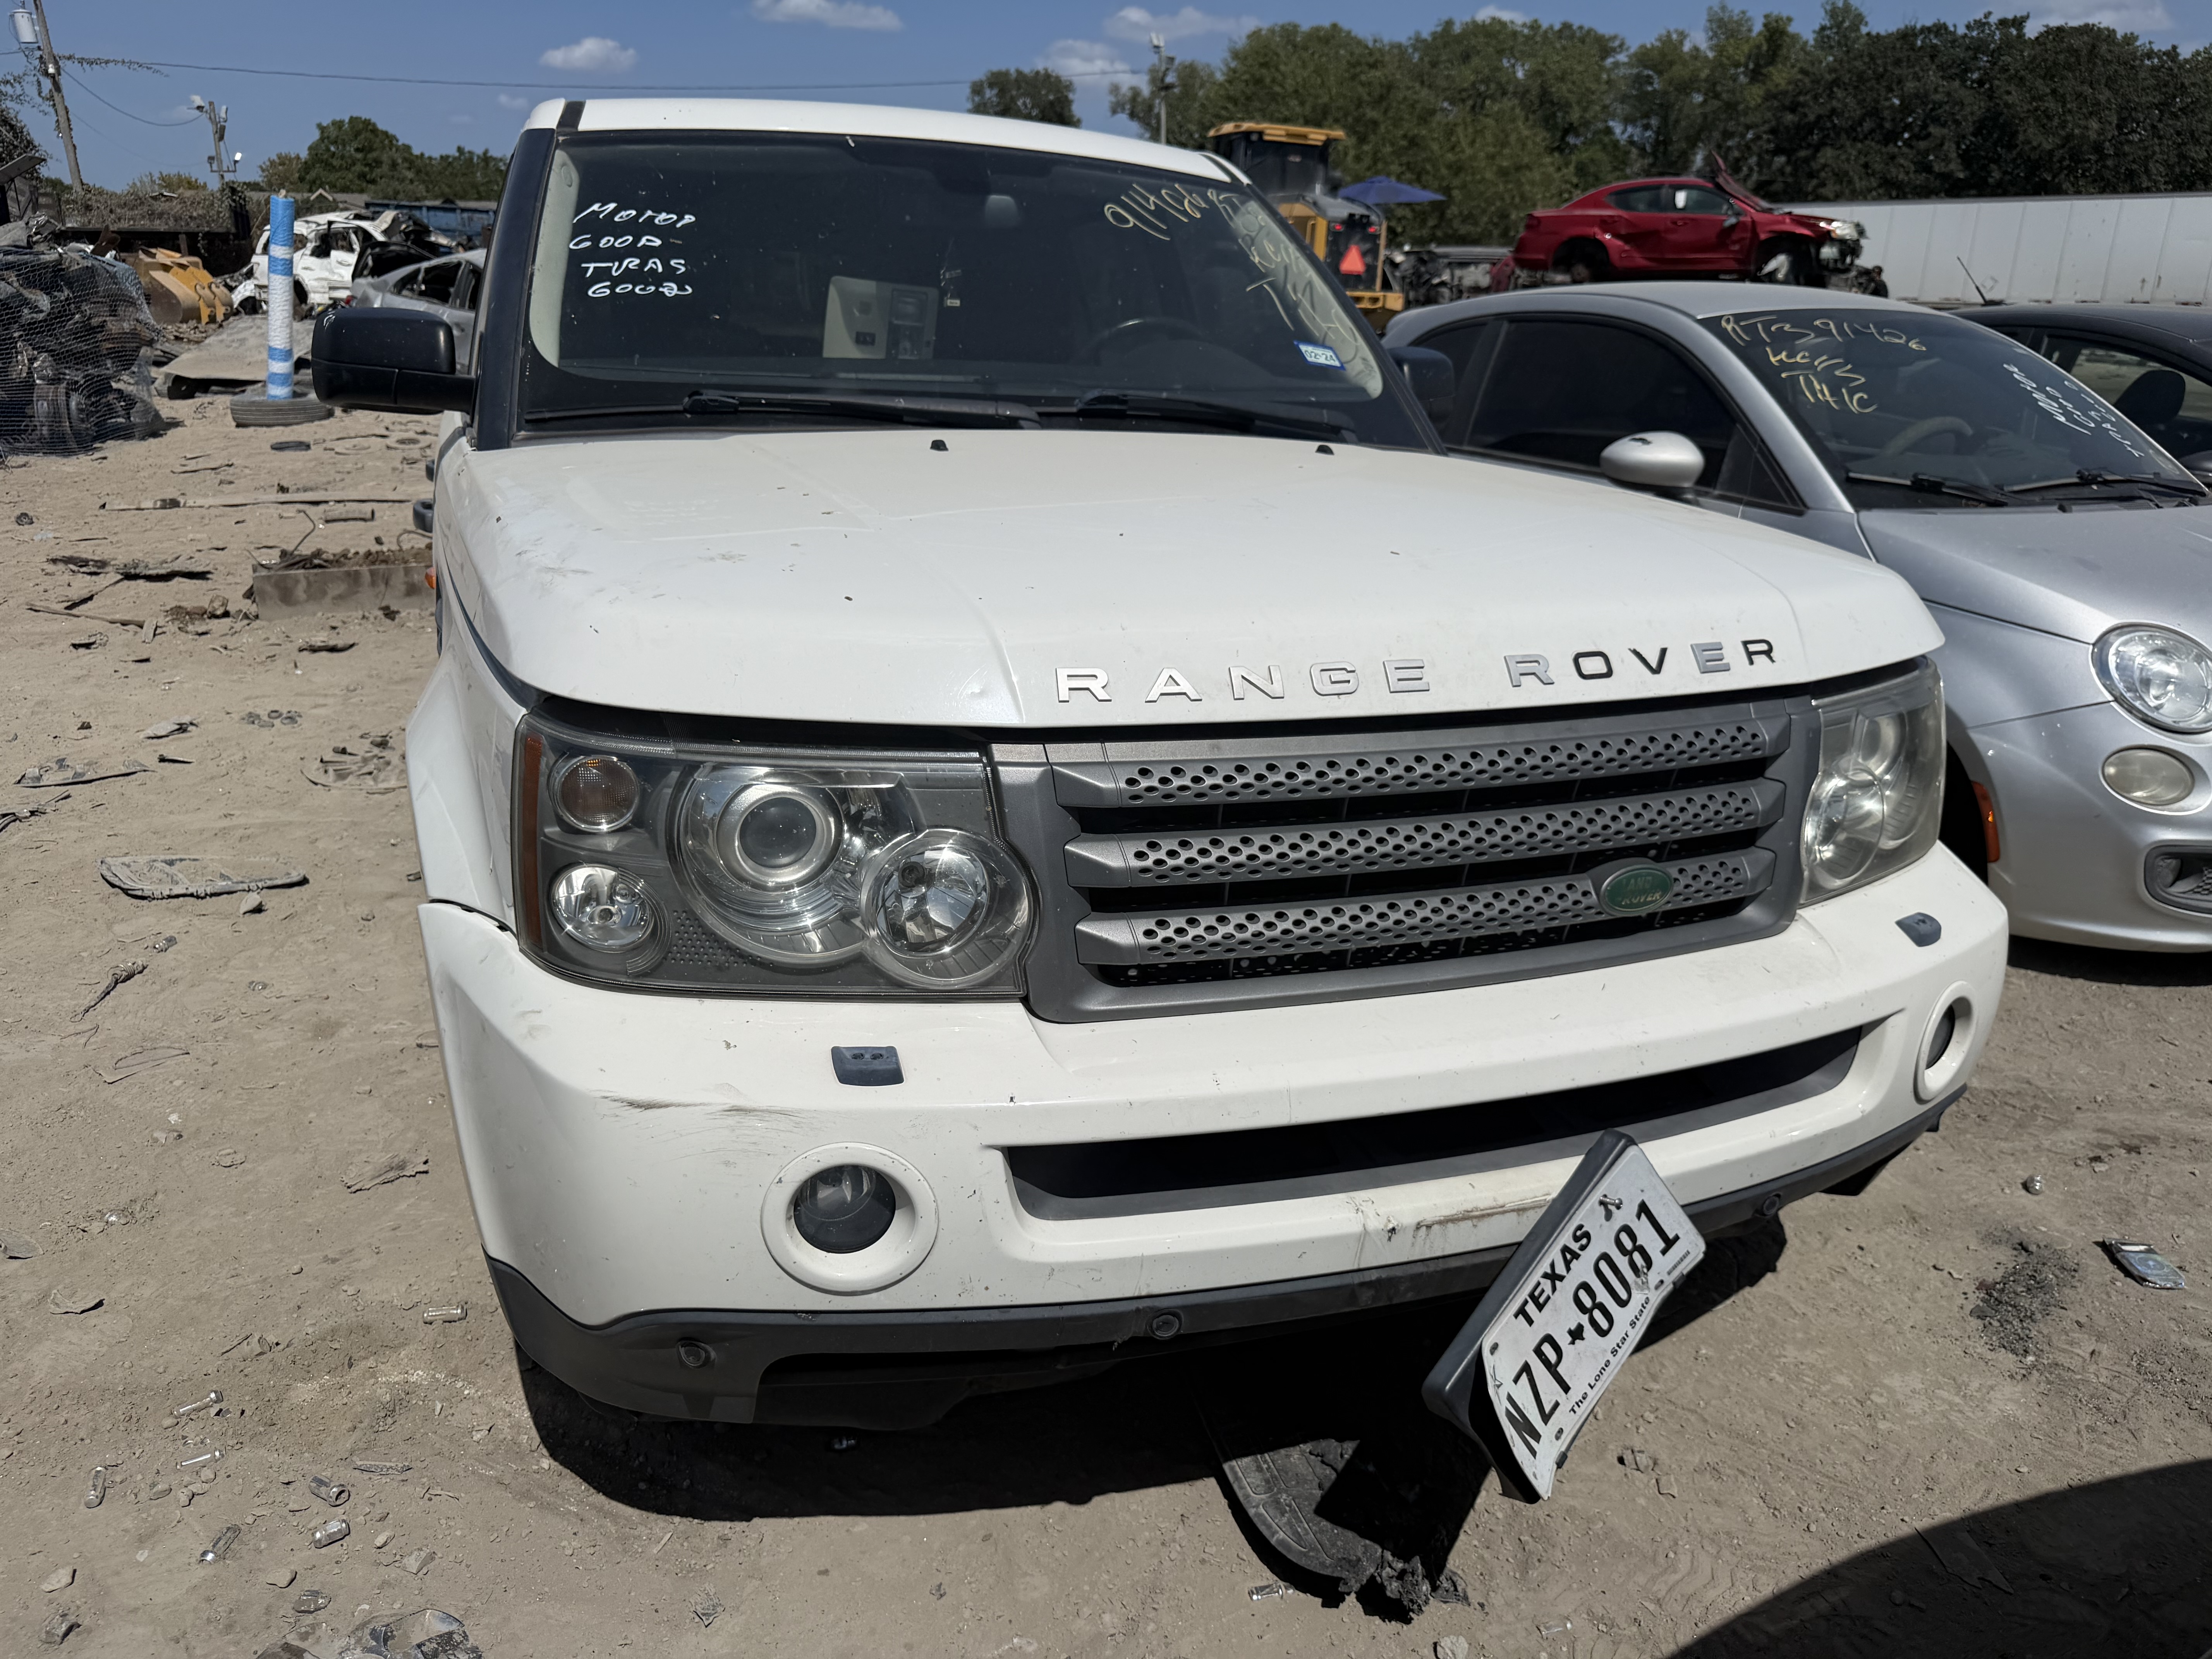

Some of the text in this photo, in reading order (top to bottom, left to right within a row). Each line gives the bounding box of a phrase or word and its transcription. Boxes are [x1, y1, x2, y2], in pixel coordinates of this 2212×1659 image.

[1056, 639, 1776, 703] RANGE ROVER
[1513, 1223, 1591, 1327] TEXAS
[1569, 1296, 1650, 1415] The Lone Star State
